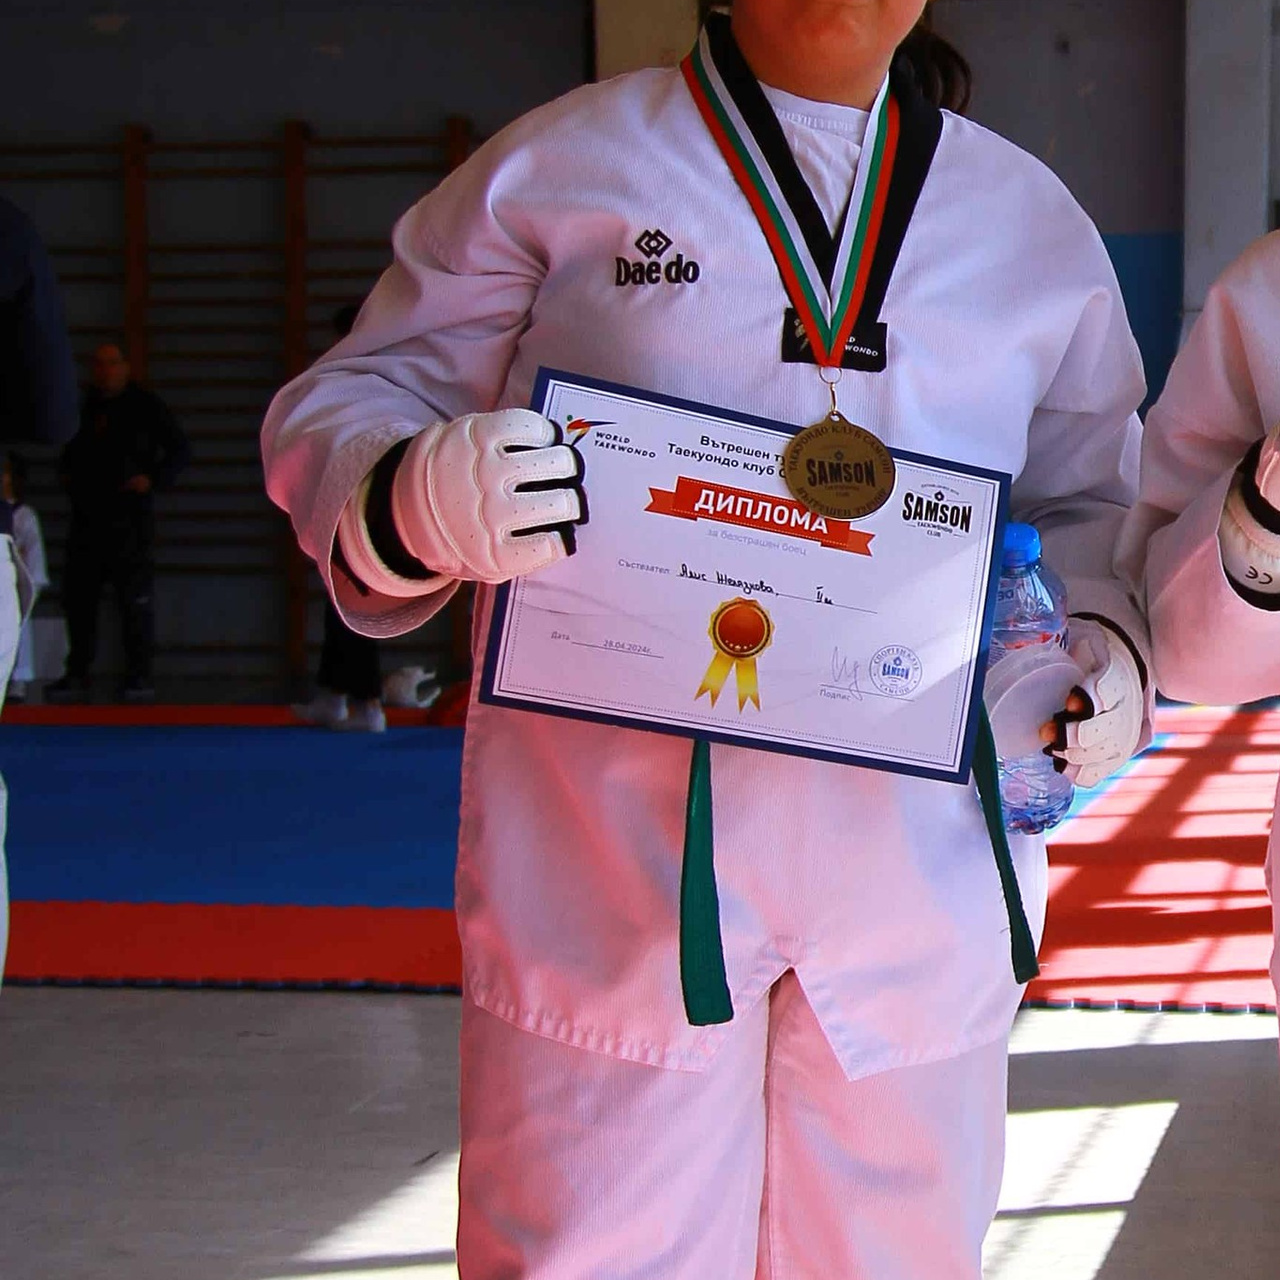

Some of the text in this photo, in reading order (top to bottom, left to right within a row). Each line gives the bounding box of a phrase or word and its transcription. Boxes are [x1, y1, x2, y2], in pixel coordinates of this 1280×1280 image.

[844, 344, 879, 357] WONDO
[594, 440, 657, 459] TAEKWONDO
[595, 431, 631, 444] WORLD
[700, 435, 771, 461] Вътрешен
[667, 442, 739, 468] Таекуондо
[743, 461, 776, 477] клуб
[805, 457, 877, 488] SAMSON
[694, 489, 829, 535] ДИПЛОМА
[902, 492, 973, 533] SAMSON
